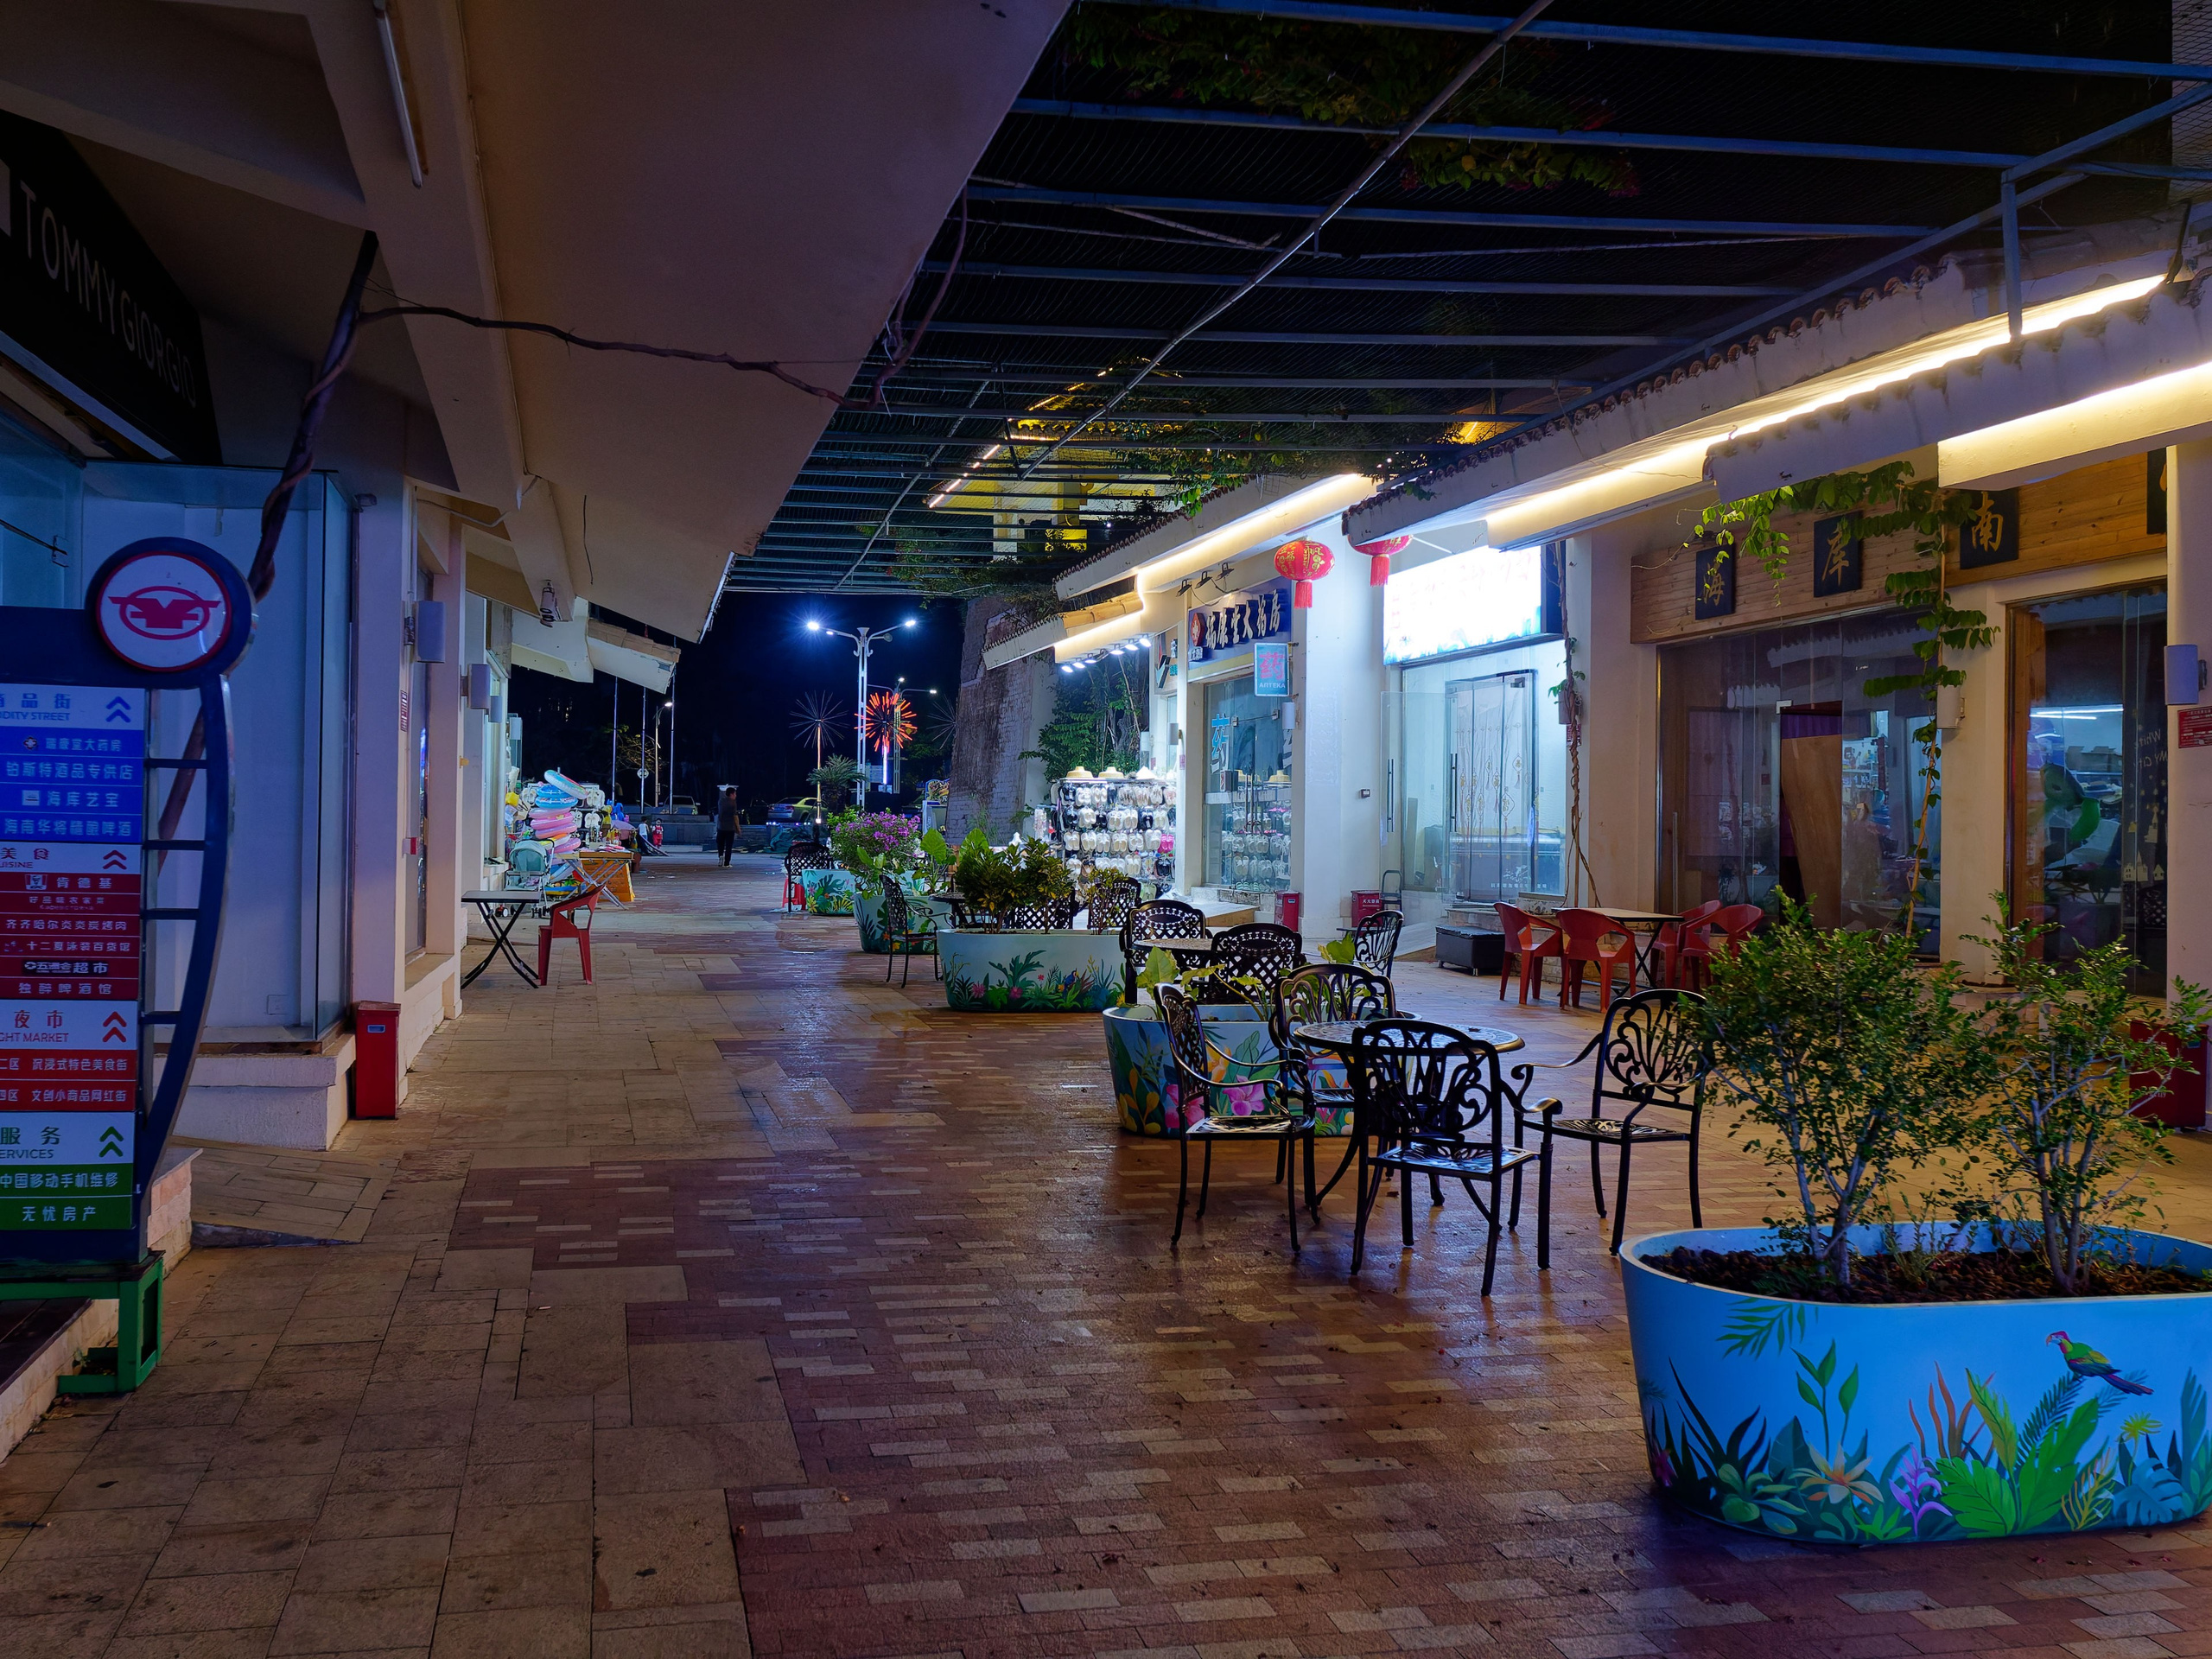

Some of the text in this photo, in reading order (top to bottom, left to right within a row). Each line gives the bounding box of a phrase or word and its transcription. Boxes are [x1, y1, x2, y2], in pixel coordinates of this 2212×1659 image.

[20, 179, 198, 410] TOMMY GIORGIO
[1968, 490, 2005, 553] 南
[1259, 652, 1285, 680] 药
[31, 711, 70, 721] STREET
[0, 847, 50, 861] 美食
[56, 876, 113, 889] 肯德基
[14, 1009, 65, 1029] 夜市
[22, 1032, 69, 1043] MARKET
[0, 1126, 61, 1146] 服务
[0, 1172, 118, 1189] 中国移动手机维修
[22, 1205, 97, 1223] 无忧房产
